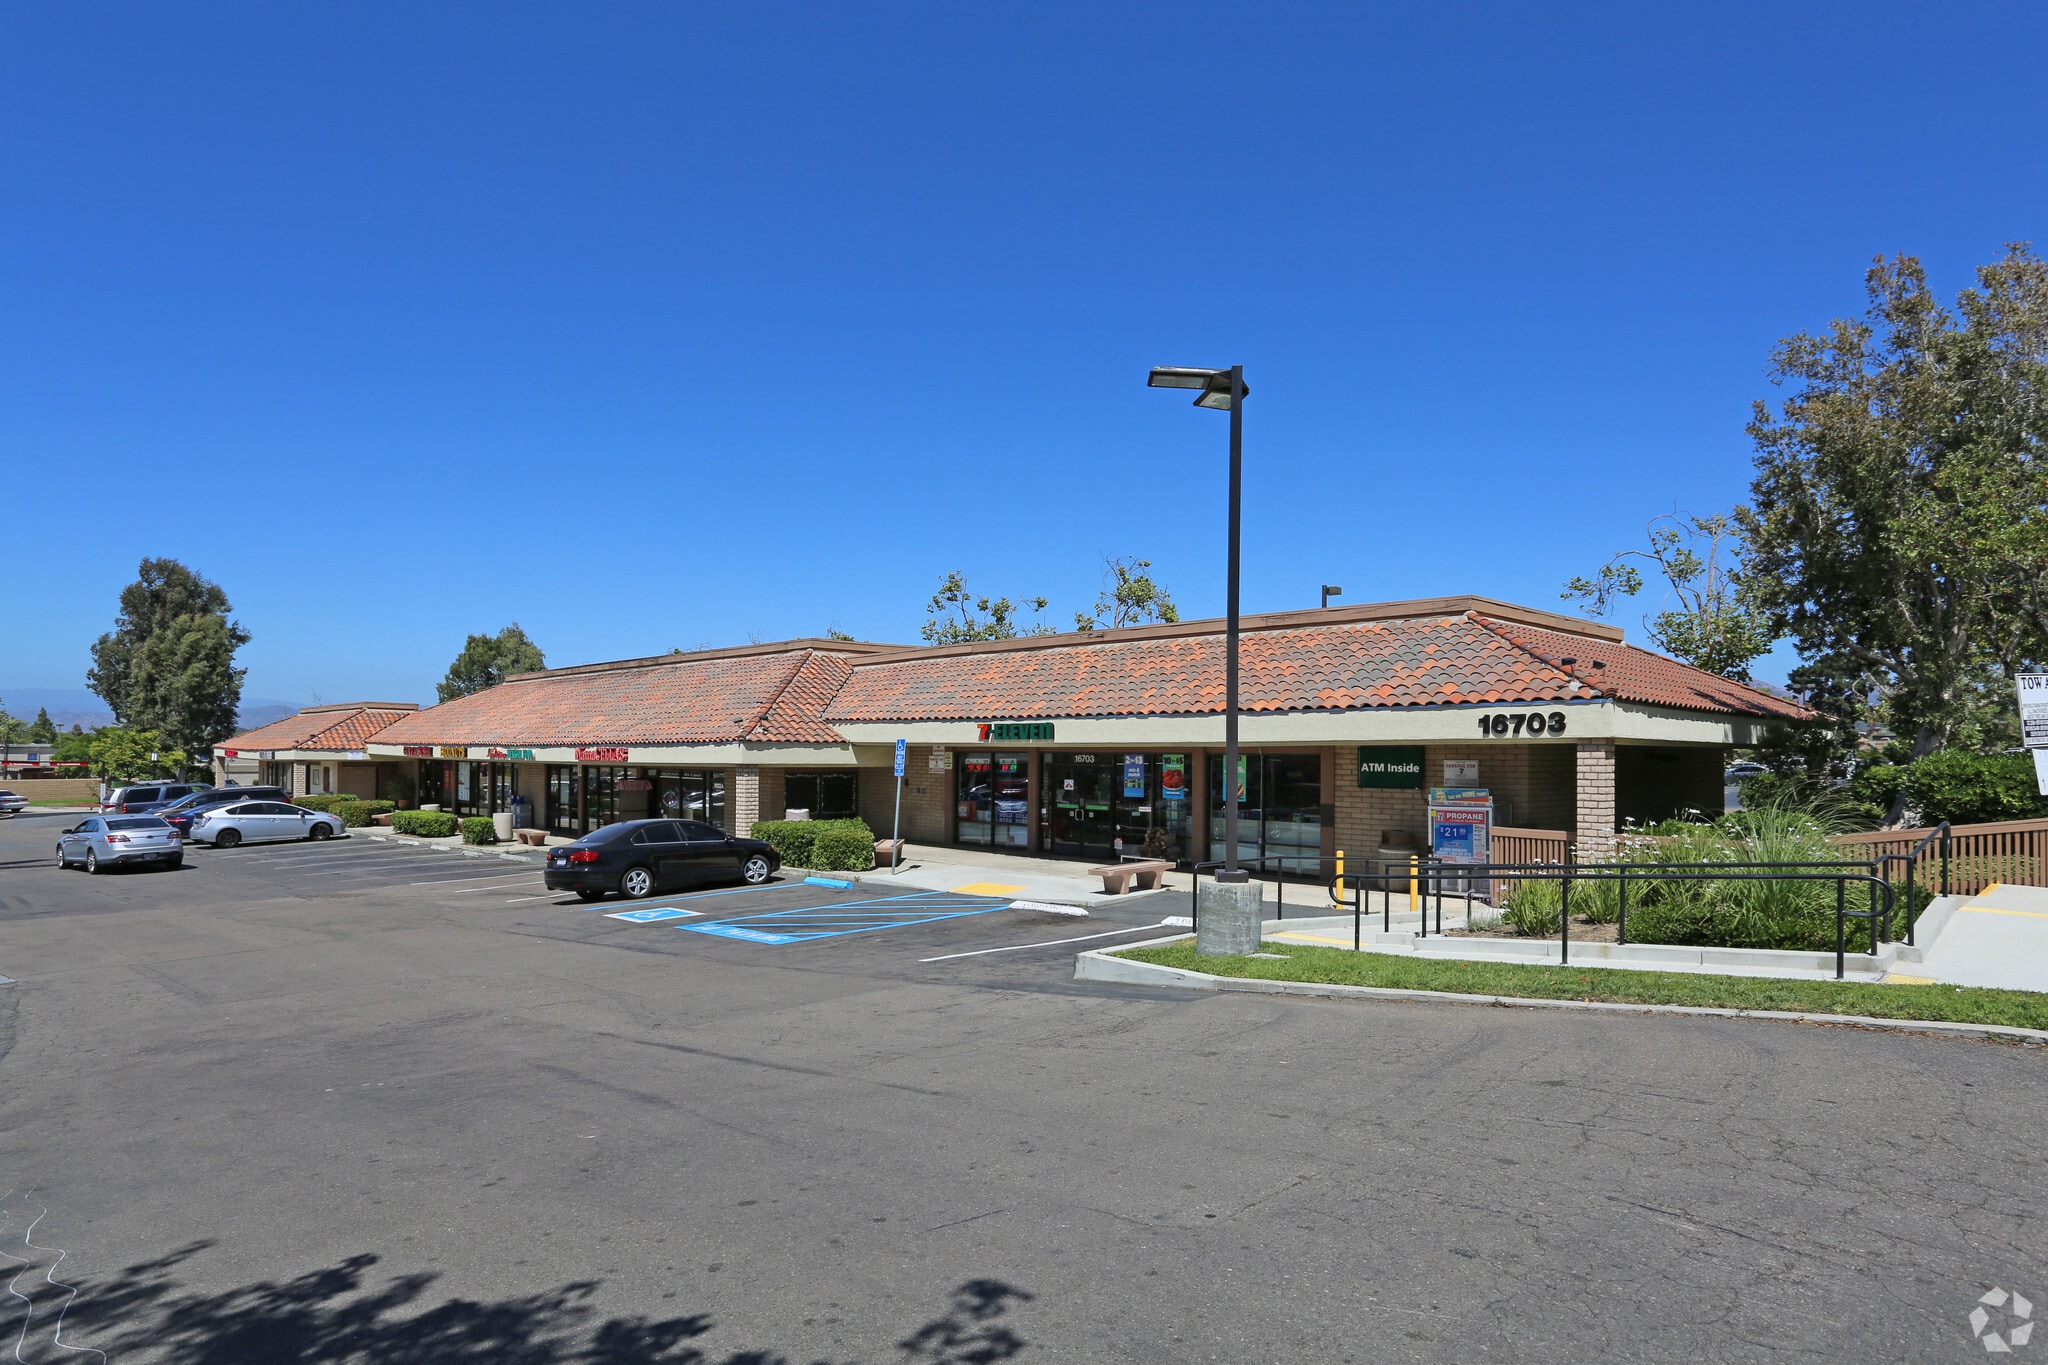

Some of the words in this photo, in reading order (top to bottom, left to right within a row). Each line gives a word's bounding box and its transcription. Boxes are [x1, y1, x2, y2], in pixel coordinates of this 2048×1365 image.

[2021, 677, 2041, 689] TOW
[1478, 712, 1566, 736] 16703
[1361, 763, 1385, 772] ATM
[1387, 763, 1420, 773] Inside
